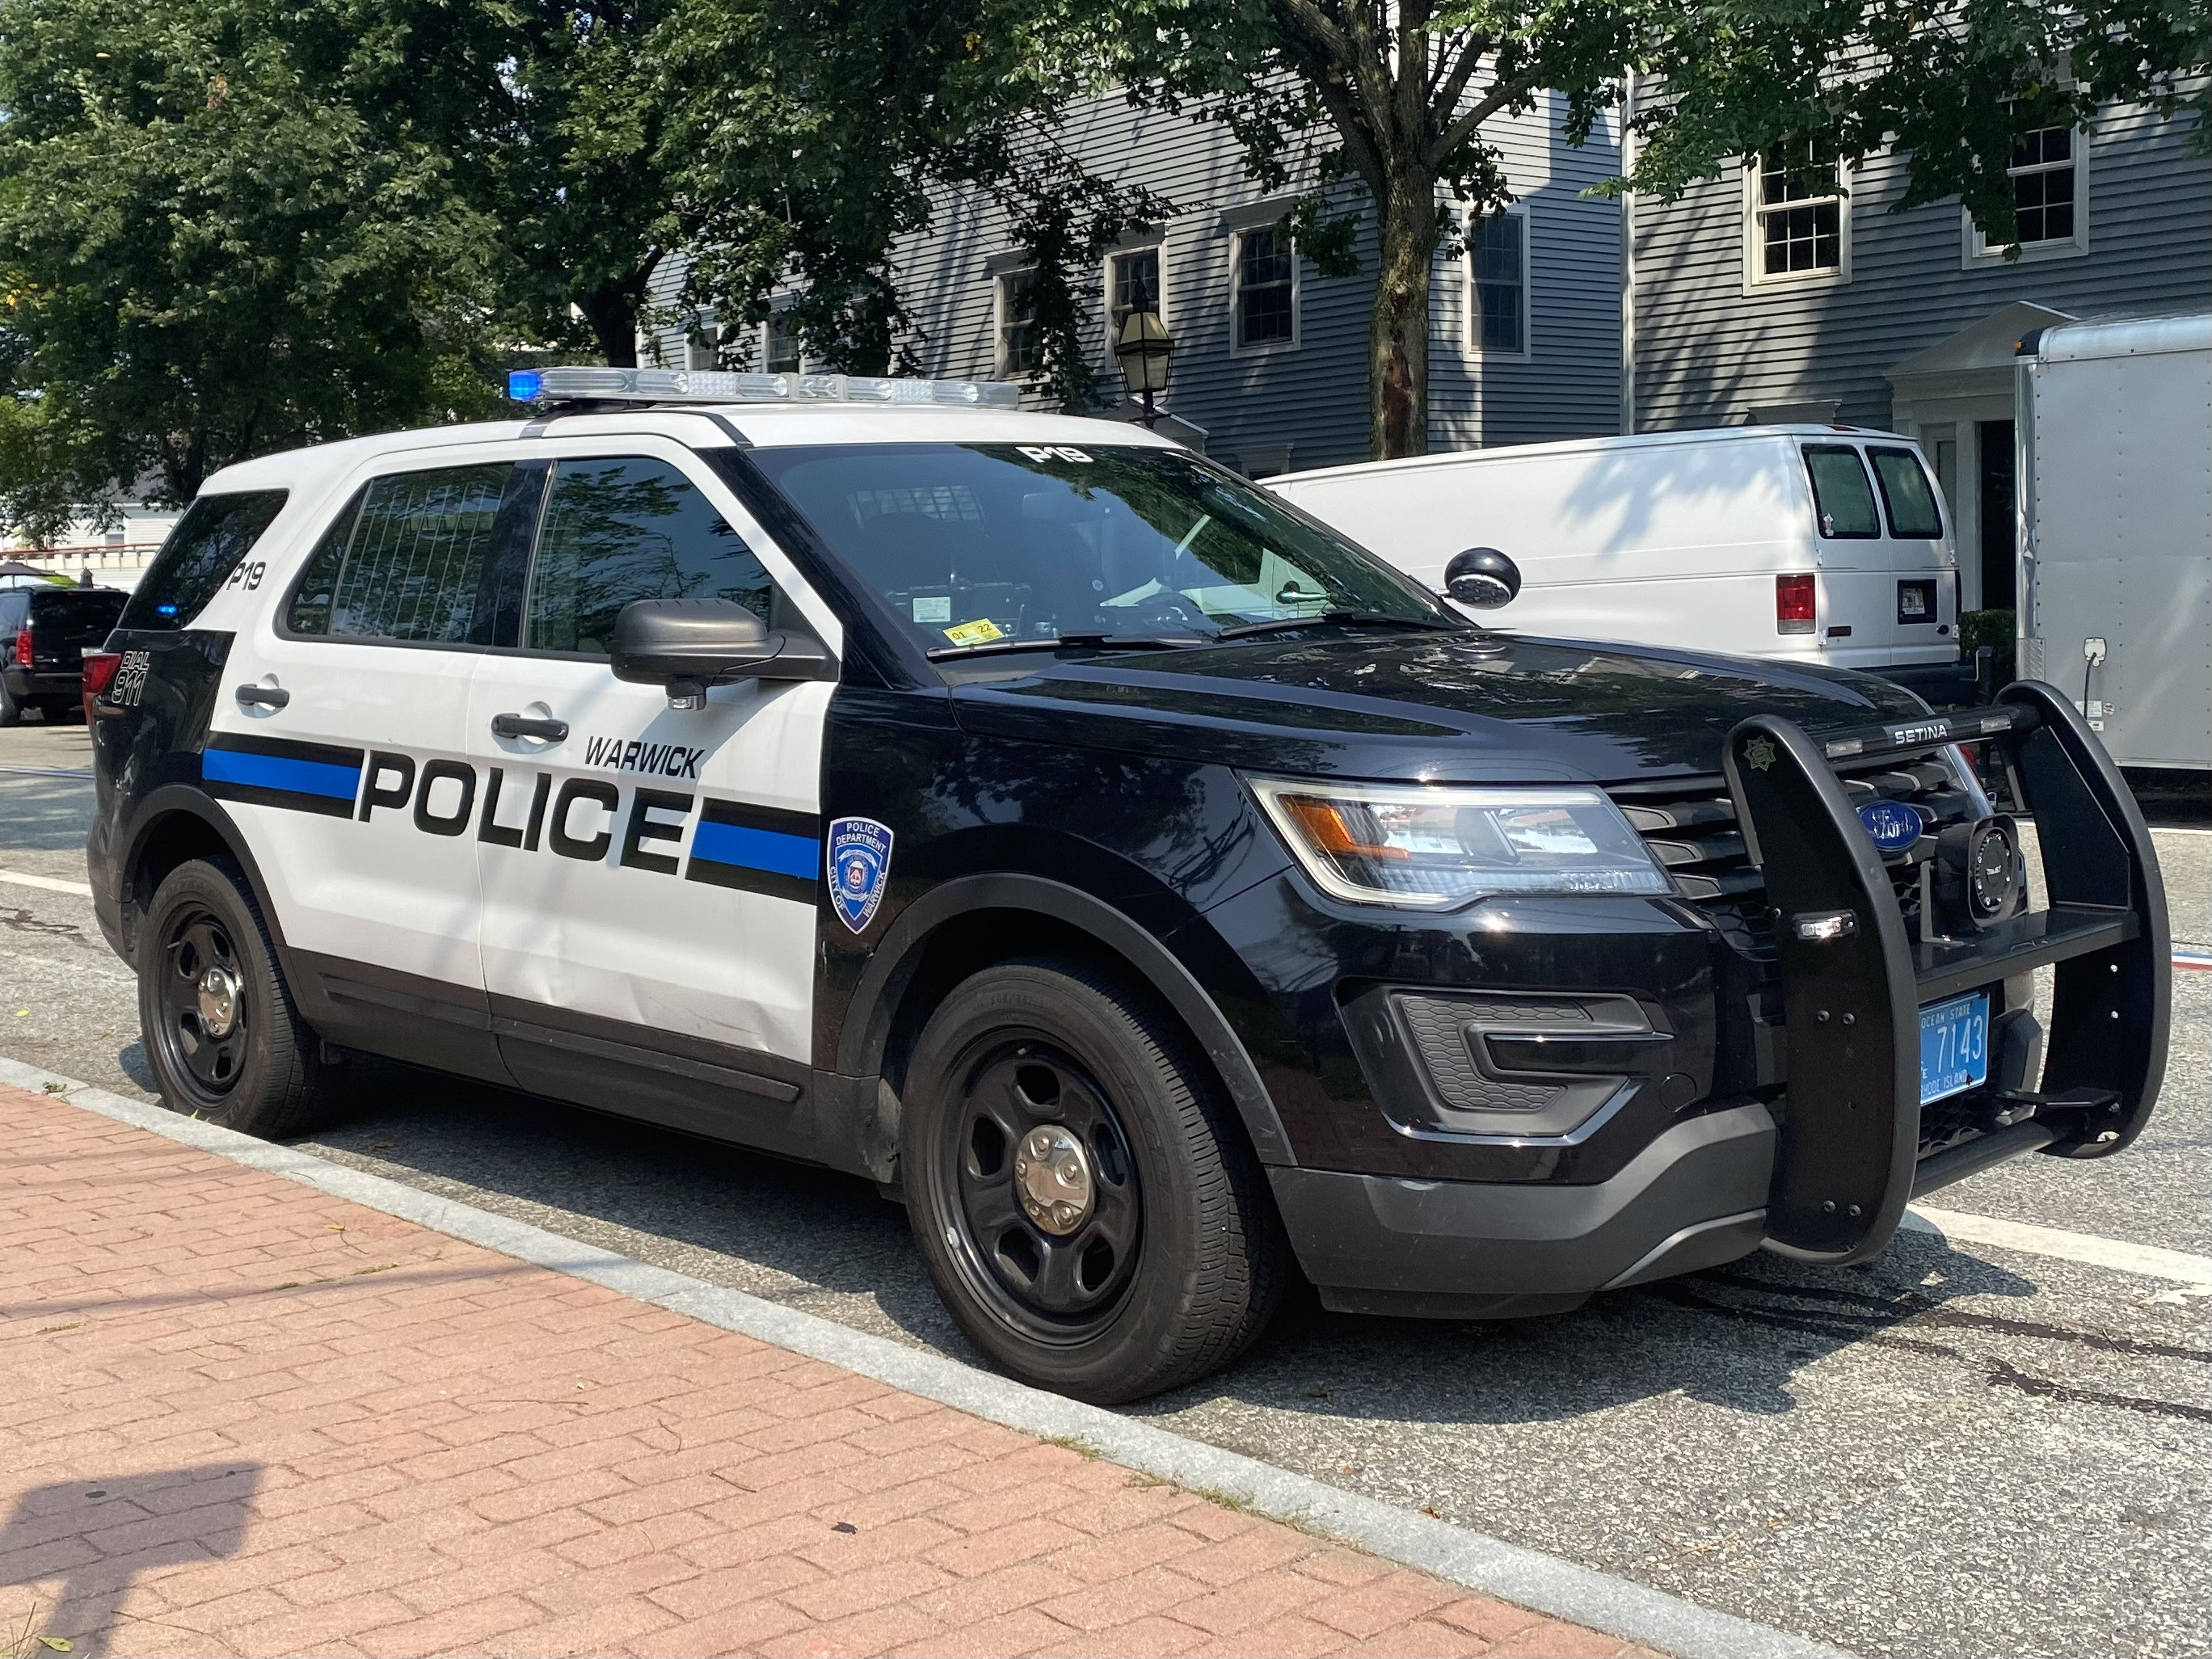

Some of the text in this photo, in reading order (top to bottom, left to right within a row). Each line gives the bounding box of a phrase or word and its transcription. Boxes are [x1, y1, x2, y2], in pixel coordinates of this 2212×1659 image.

[1015, 446, 1093, 463] P19
[226, 561, 267, 591] P19
[951, 631, 967, 640] 01
[977, 623, 992, 634] 22
[120, 651, 150, 671] DIAL
[112, 669, 147, 706] 911
[1894, 724, 1948, 745] SETINA
[584, 736, 705, 779] WARWICK
[358, 749, 694, 876] POLICE
[846, 822, 880, 838] POLICE
[836, 833, 887, 853] DEPARTMENT
[829, 865, 841, 893] CITY
[834, 894, 846, 912] OF
[862, 870, 886, 918] WARWICK
[1921, 1003, 1971, 1030] OCEAN STATE
[1937, 1015, 1982, 1073] 7143
[1944, 1069, 1967, 1089] ISLAND
